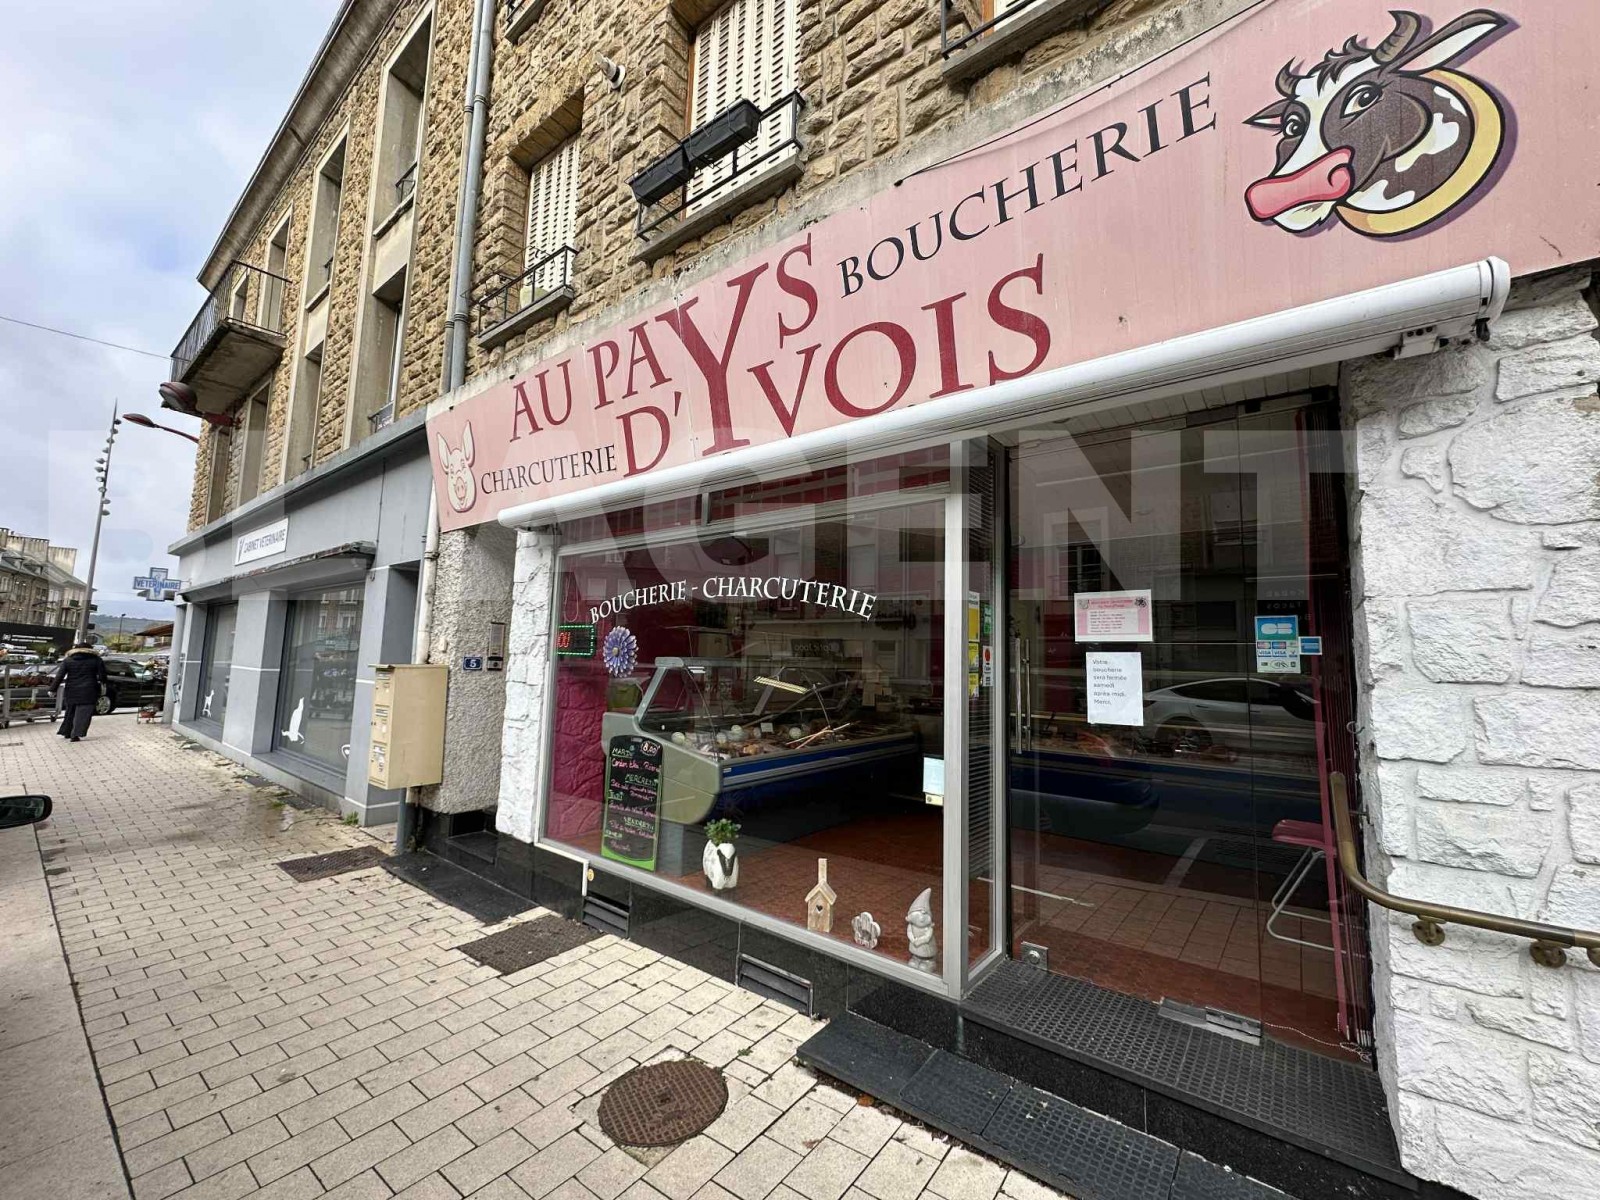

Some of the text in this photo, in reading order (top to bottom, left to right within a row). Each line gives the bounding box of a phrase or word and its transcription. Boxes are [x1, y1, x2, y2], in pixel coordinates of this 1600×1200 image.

[840, 71, 1217, 298] BOUCHERIE
[509, 360, 573, 443] AU
[481, 444, 617, 495] CHARCUTERIE
[589, 579, 688, 624] BOUCHERIE
[702, 576, 878, 621] CHARCUTERIE
[469, 660, 477, 668] 5
